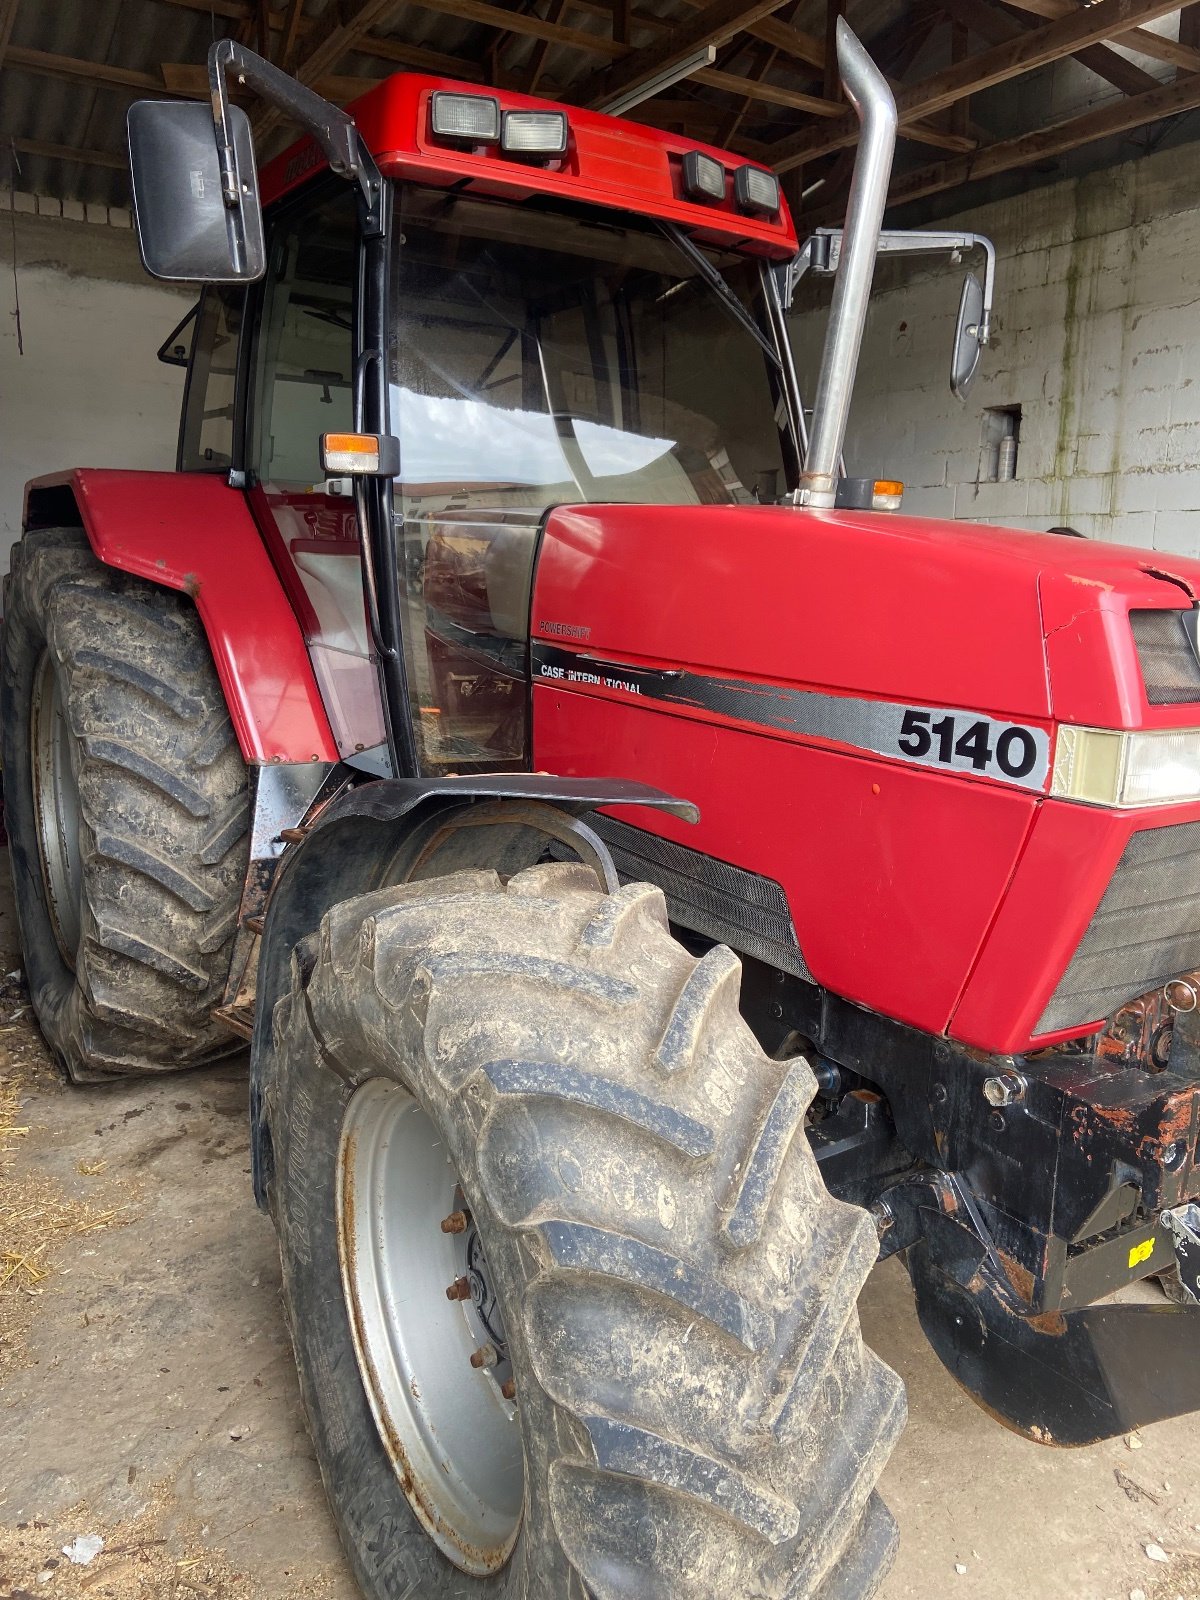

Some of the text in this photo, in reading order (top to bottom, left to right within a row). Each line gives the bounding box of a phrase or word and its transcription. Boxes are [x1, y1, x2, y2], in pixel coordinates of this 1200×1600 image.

[540, 621, 591, 639] POWERSHIFT
[541, 664, 565, 679] CASE
[898, 710, 1037, 778] 5140
